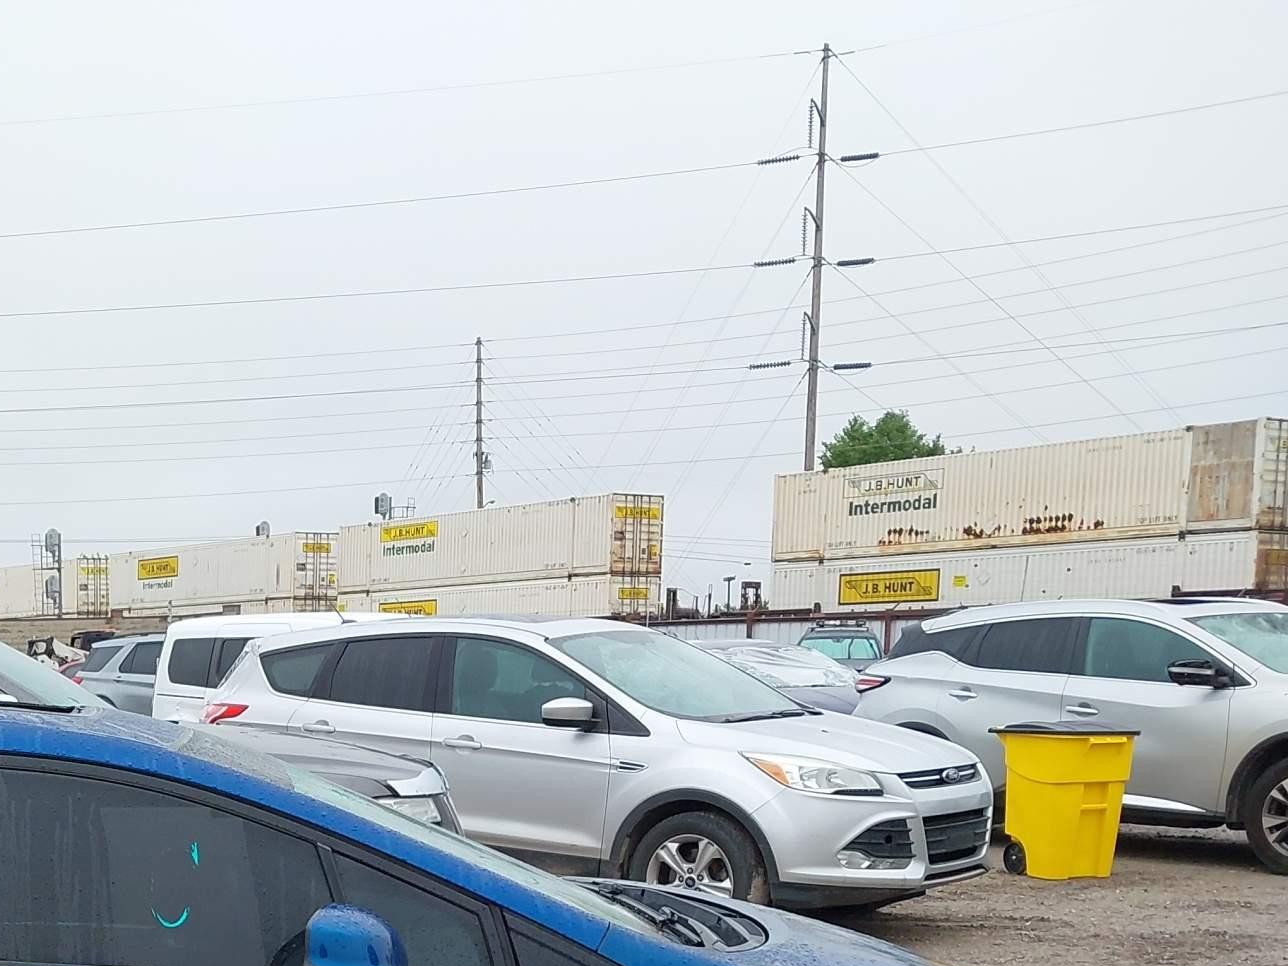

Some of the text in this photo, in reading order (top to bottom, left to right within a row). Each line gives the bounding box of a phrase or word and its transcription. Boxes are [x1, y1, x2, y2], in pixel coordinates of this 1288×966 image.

[848, 493, 937, 516] Intermodal
[383, 540, 435, 557] Intermodal
[884, 581, 914, 593] HUNT
